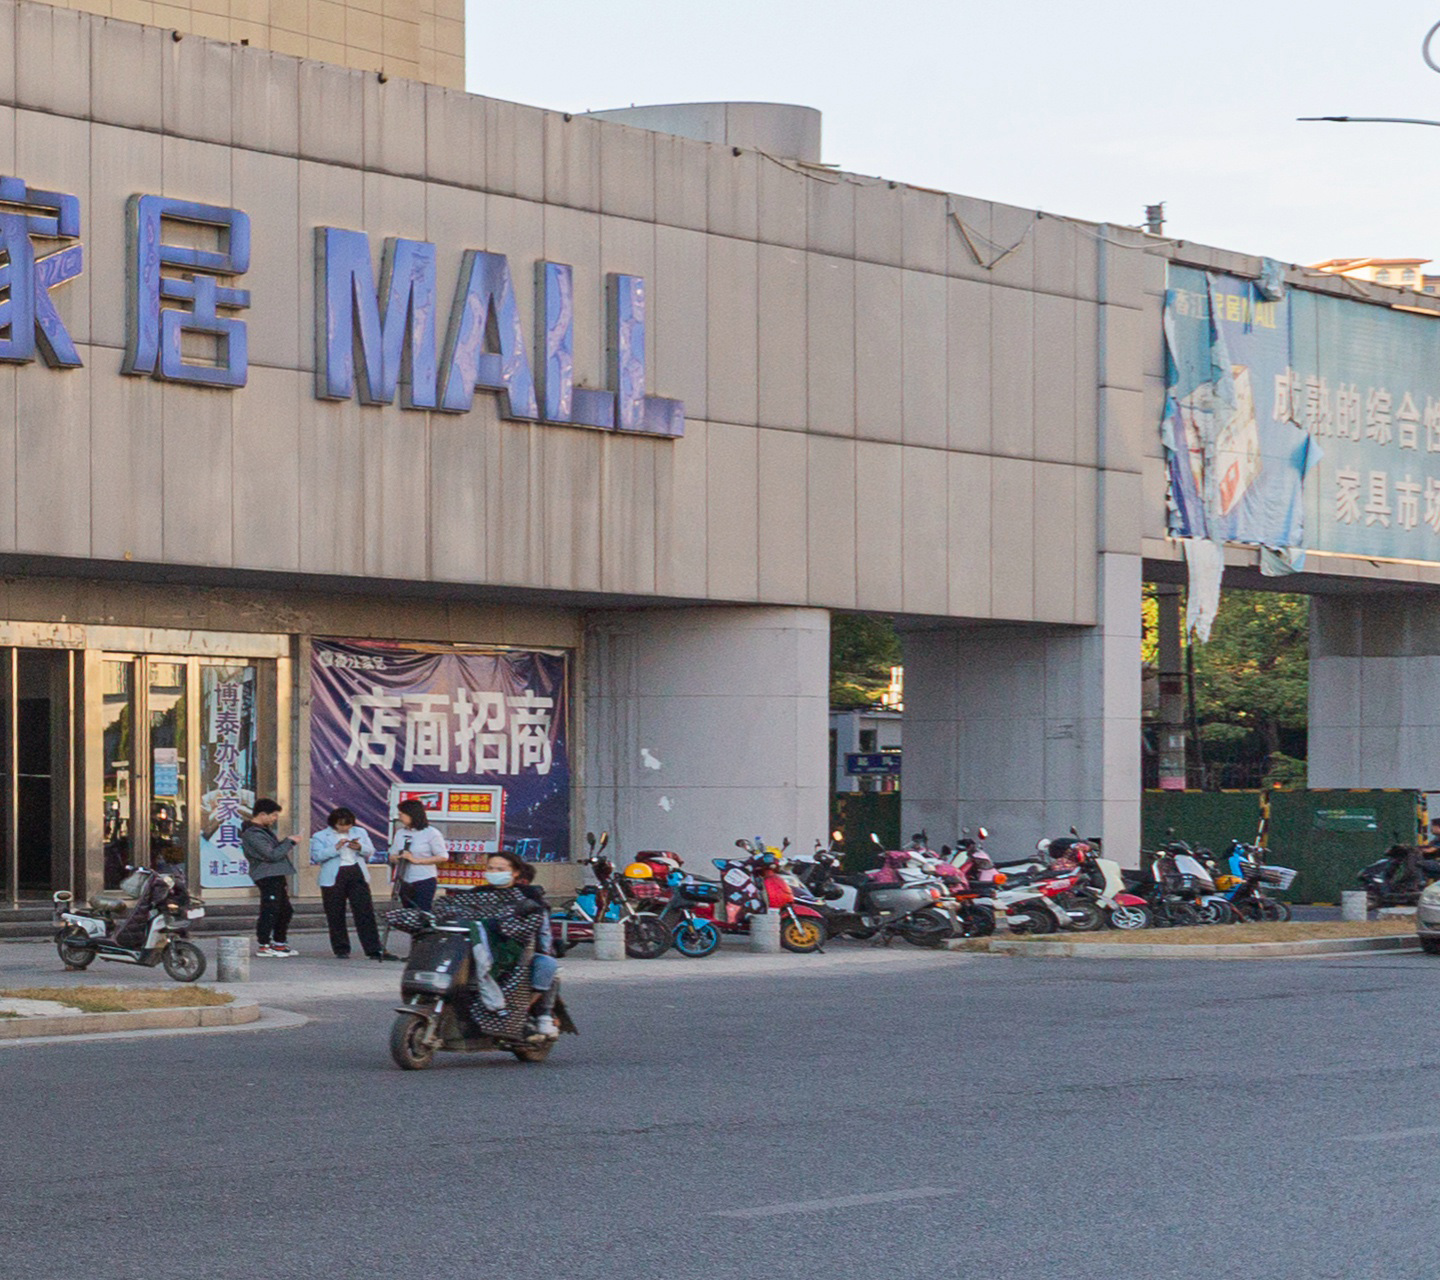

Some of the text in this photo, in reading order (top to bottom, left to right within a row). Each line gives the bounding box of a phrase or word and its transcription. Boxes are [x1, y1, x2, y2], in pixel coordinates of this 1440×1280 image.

[313, 225, 685, 439] MALL
[214, 681, 243, 849] 博泰办公家具
[344, 686, 554, 776] 店面招商
